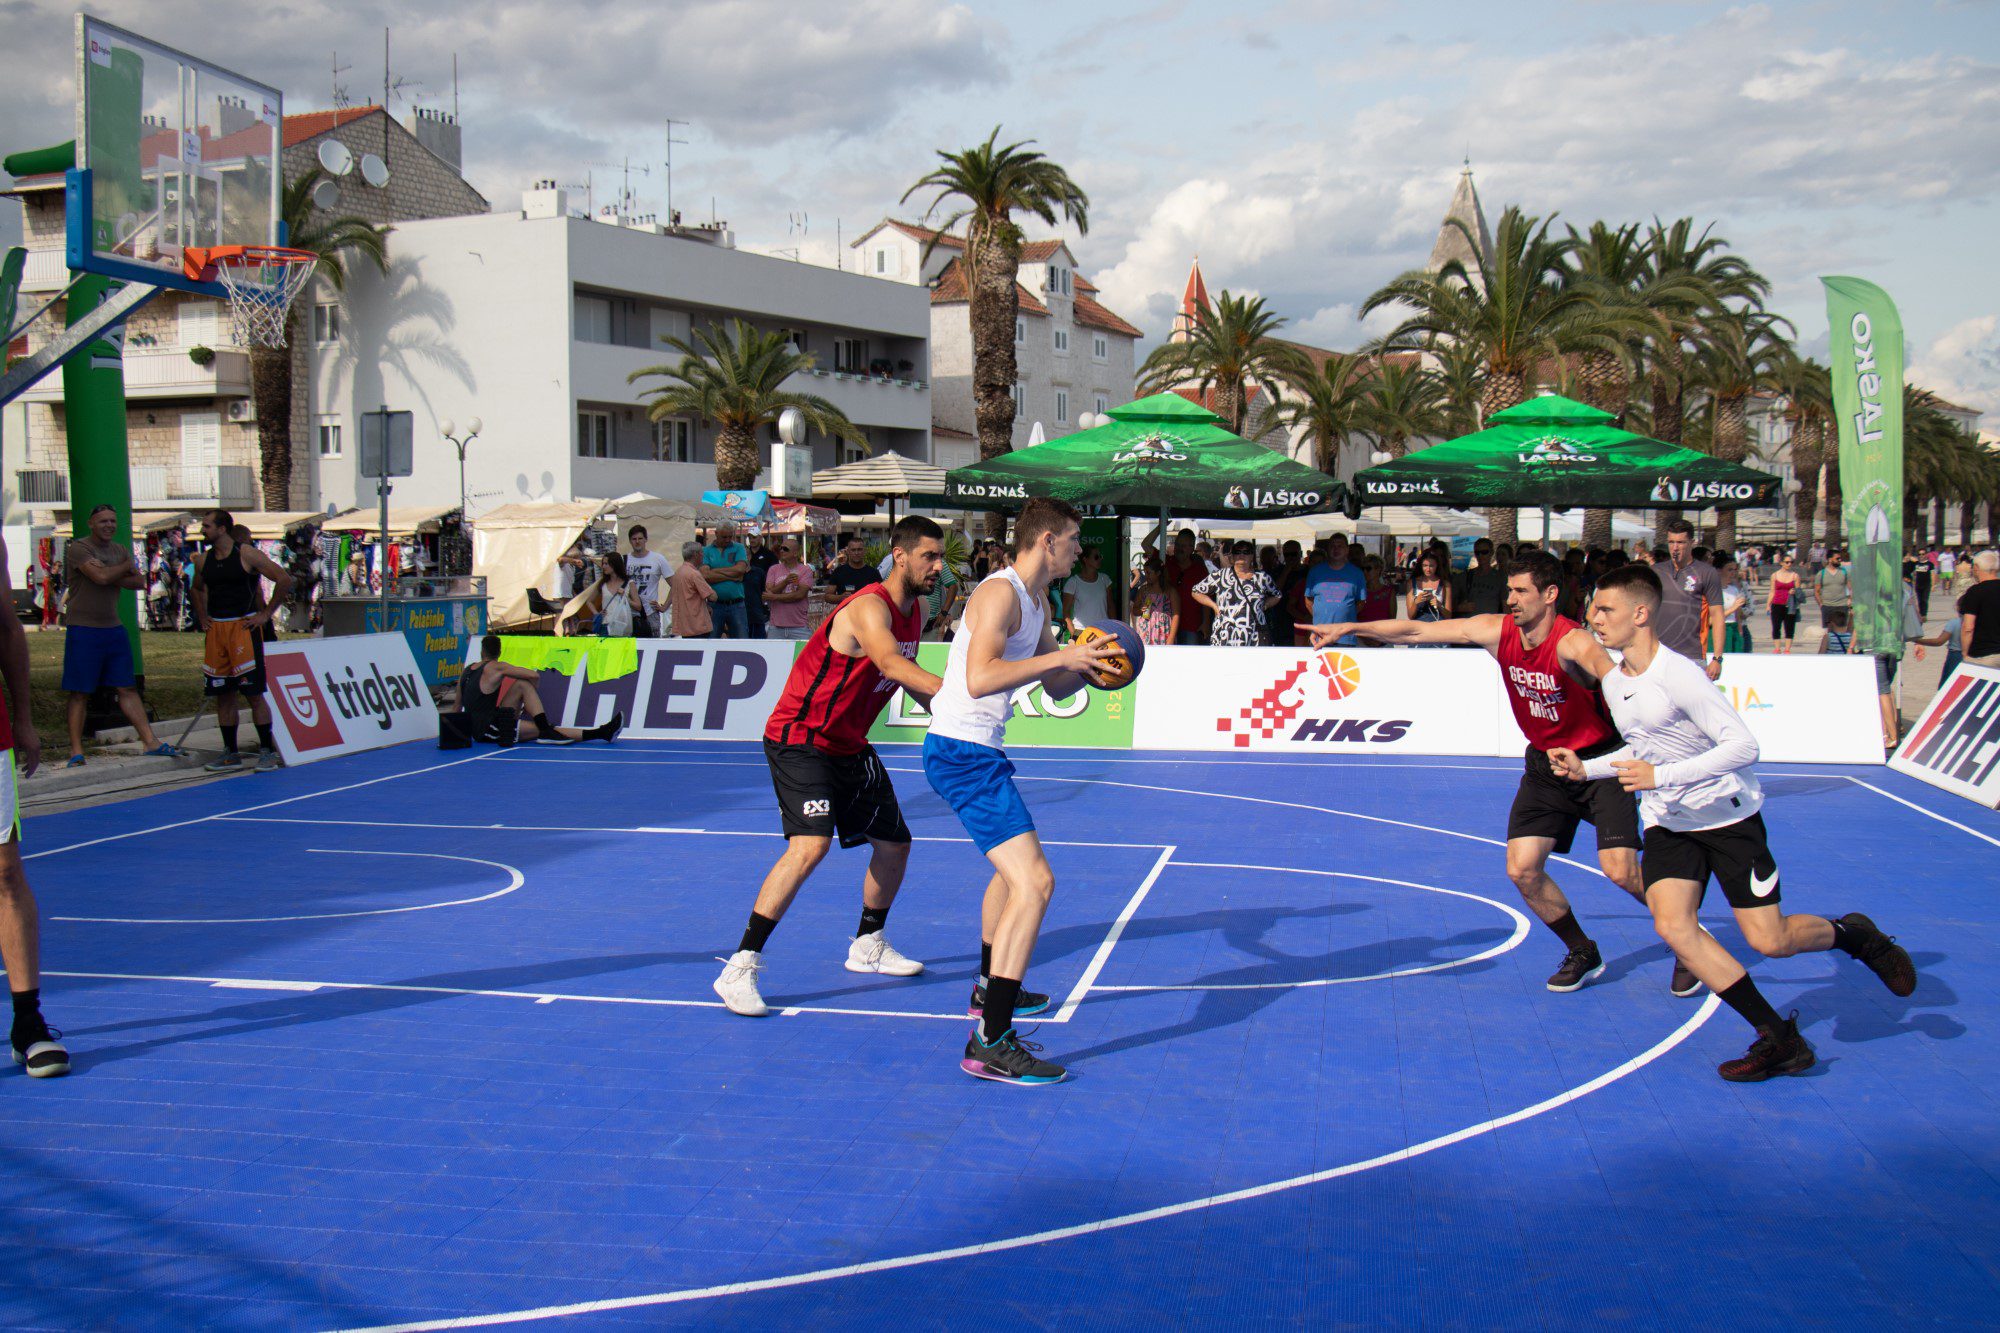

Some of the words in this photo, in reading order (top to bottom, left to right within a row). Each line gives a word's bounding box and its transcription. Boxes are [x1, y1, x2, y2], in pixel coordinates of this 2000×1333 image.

[957, 483, 986, 496] KAD
[988, 482, 1030, 498] ZNAŠ.
[1253, 488, 1320, 509] LAŠKO
[1366, 482, 1397, 494] KAD
[1400, 479, 1444, 495] ZNAŠ.
[1681, 479, 1753, 502] LAŠKO
[424, 630, 458, 653] Pancakes
[1508, 665, 1561, 691] GENERAL
[324, 662, 421, 730] triglav
[573, 649, 768, 731] HEP
[1290, 718, 1414, 743] HKS
